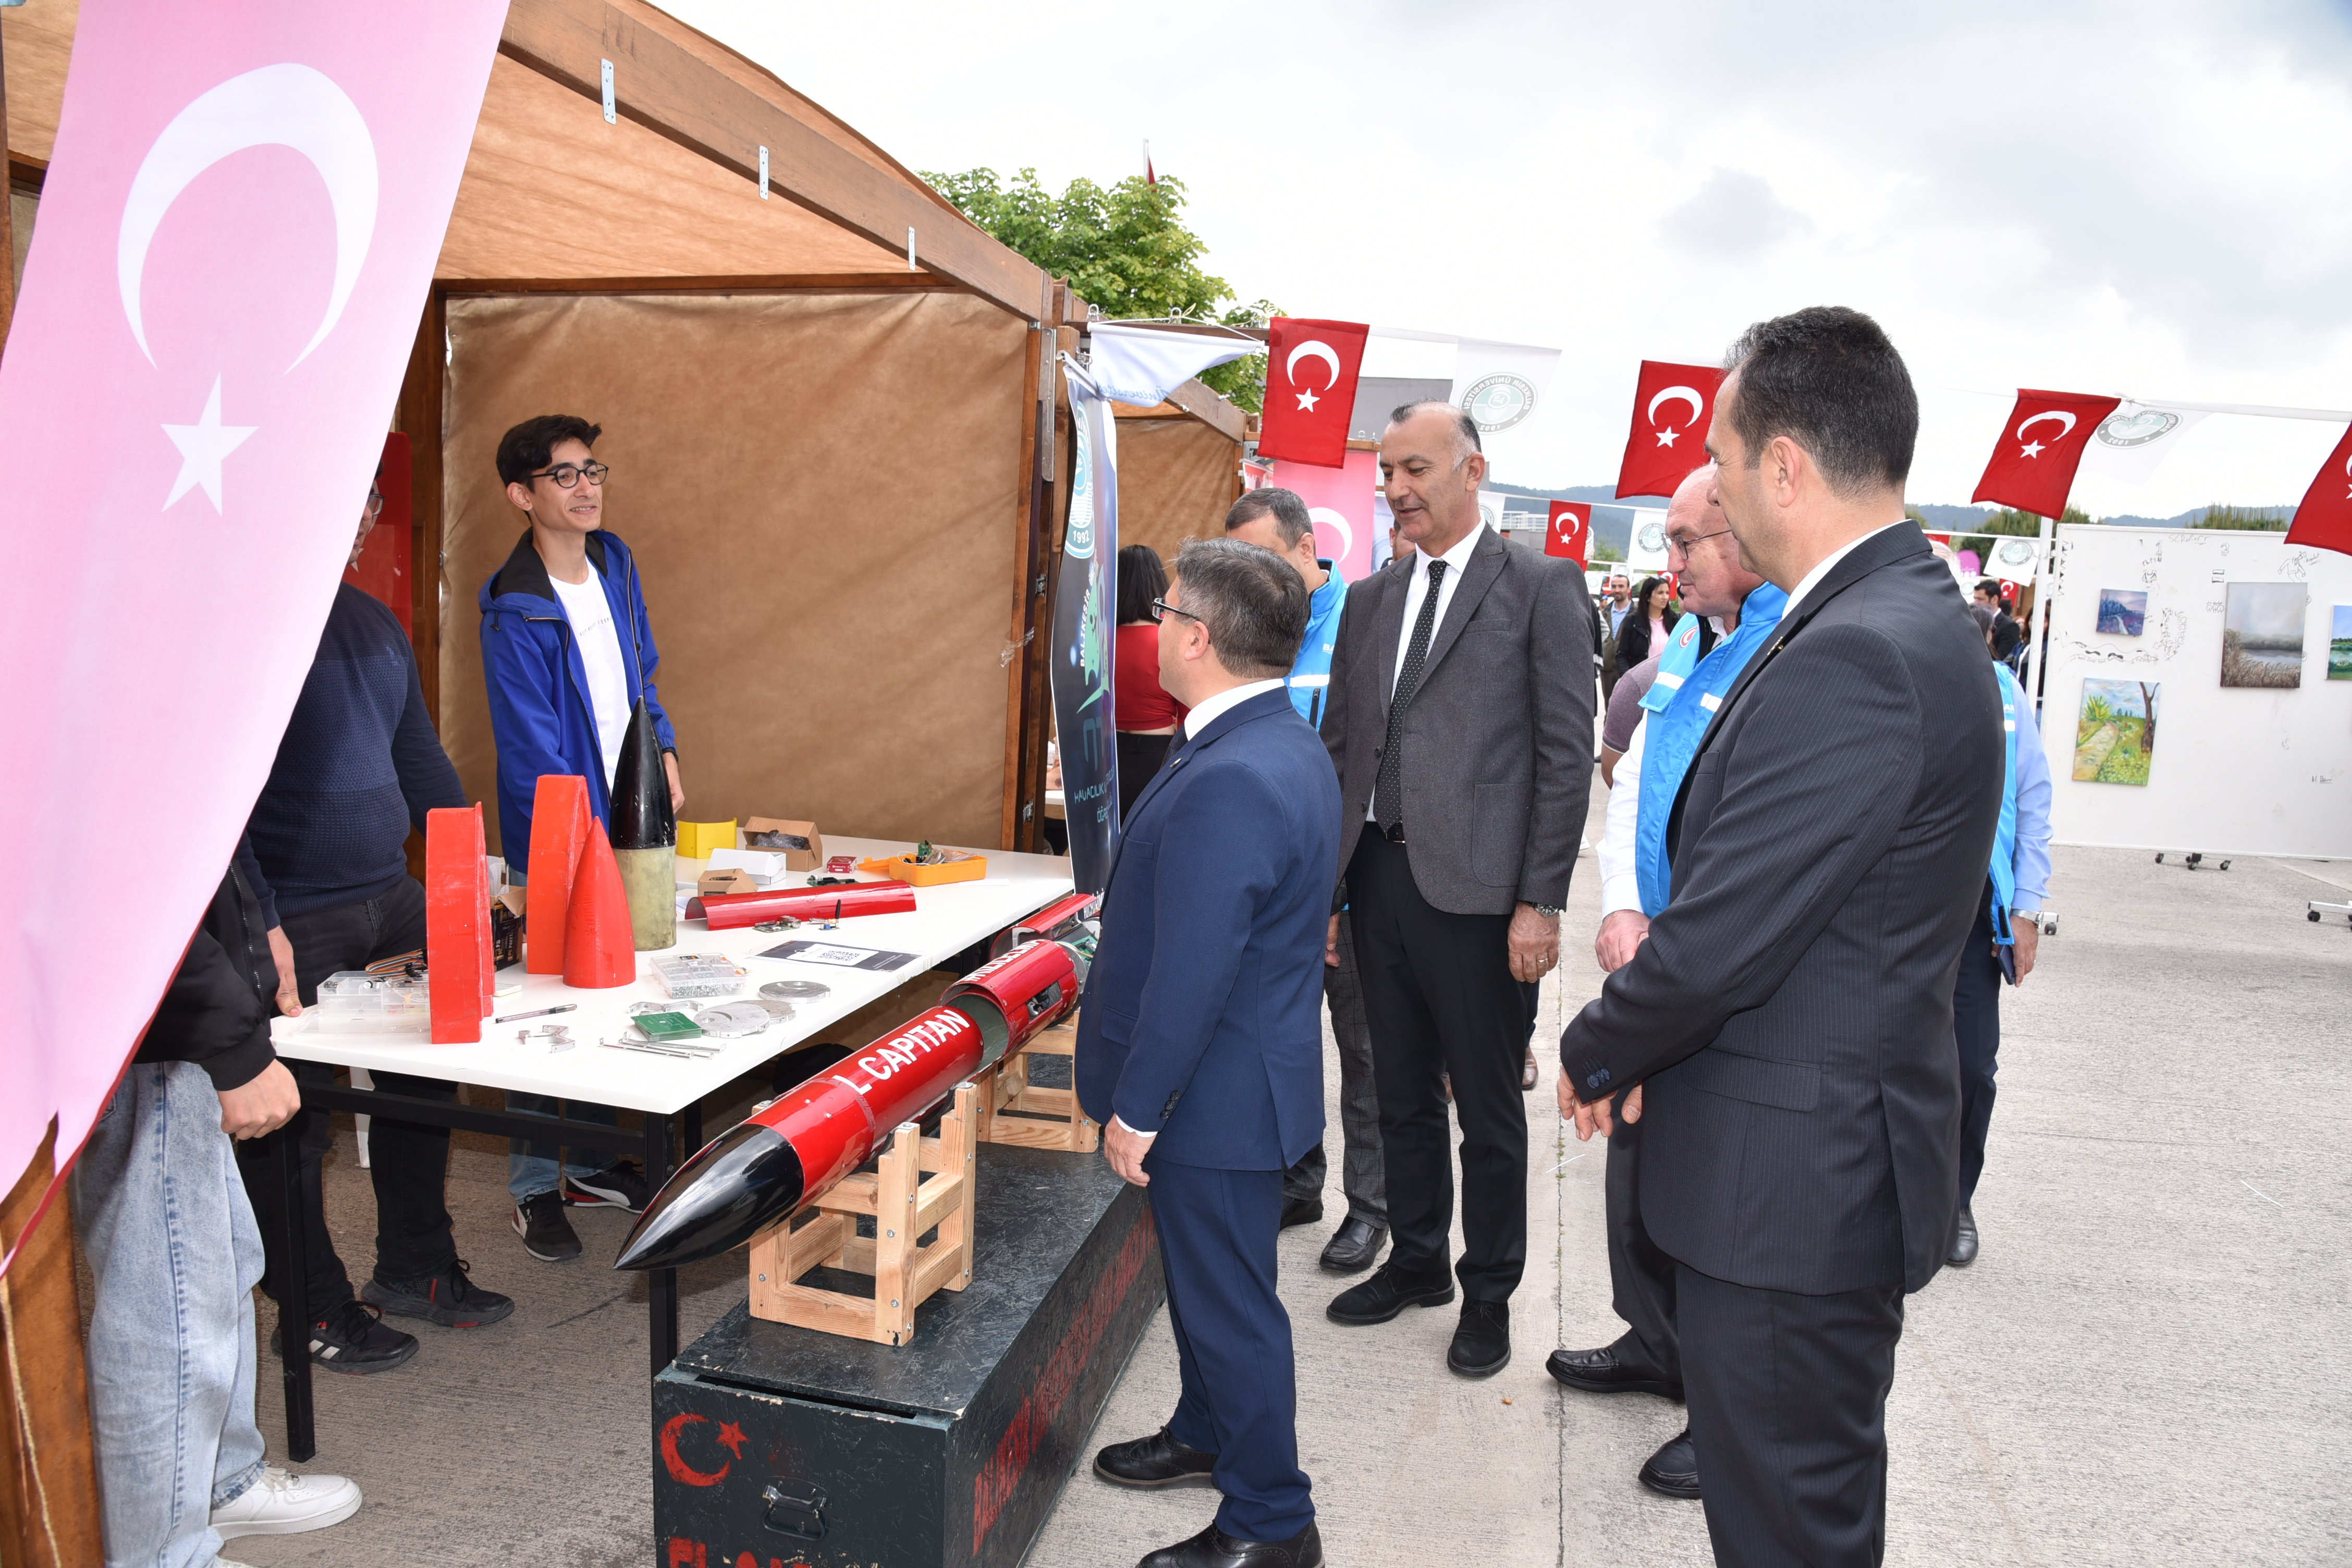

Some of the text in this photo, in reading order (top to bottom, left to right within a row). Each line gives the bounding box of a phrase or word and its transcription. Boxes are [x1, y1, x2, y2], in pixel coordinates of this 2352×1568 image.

[1073, 530, 1089, 544] 1992
[1080, 589, 1091, 667] BALIKESİR
[858, 1009, 970, 1080] CAPITAN
